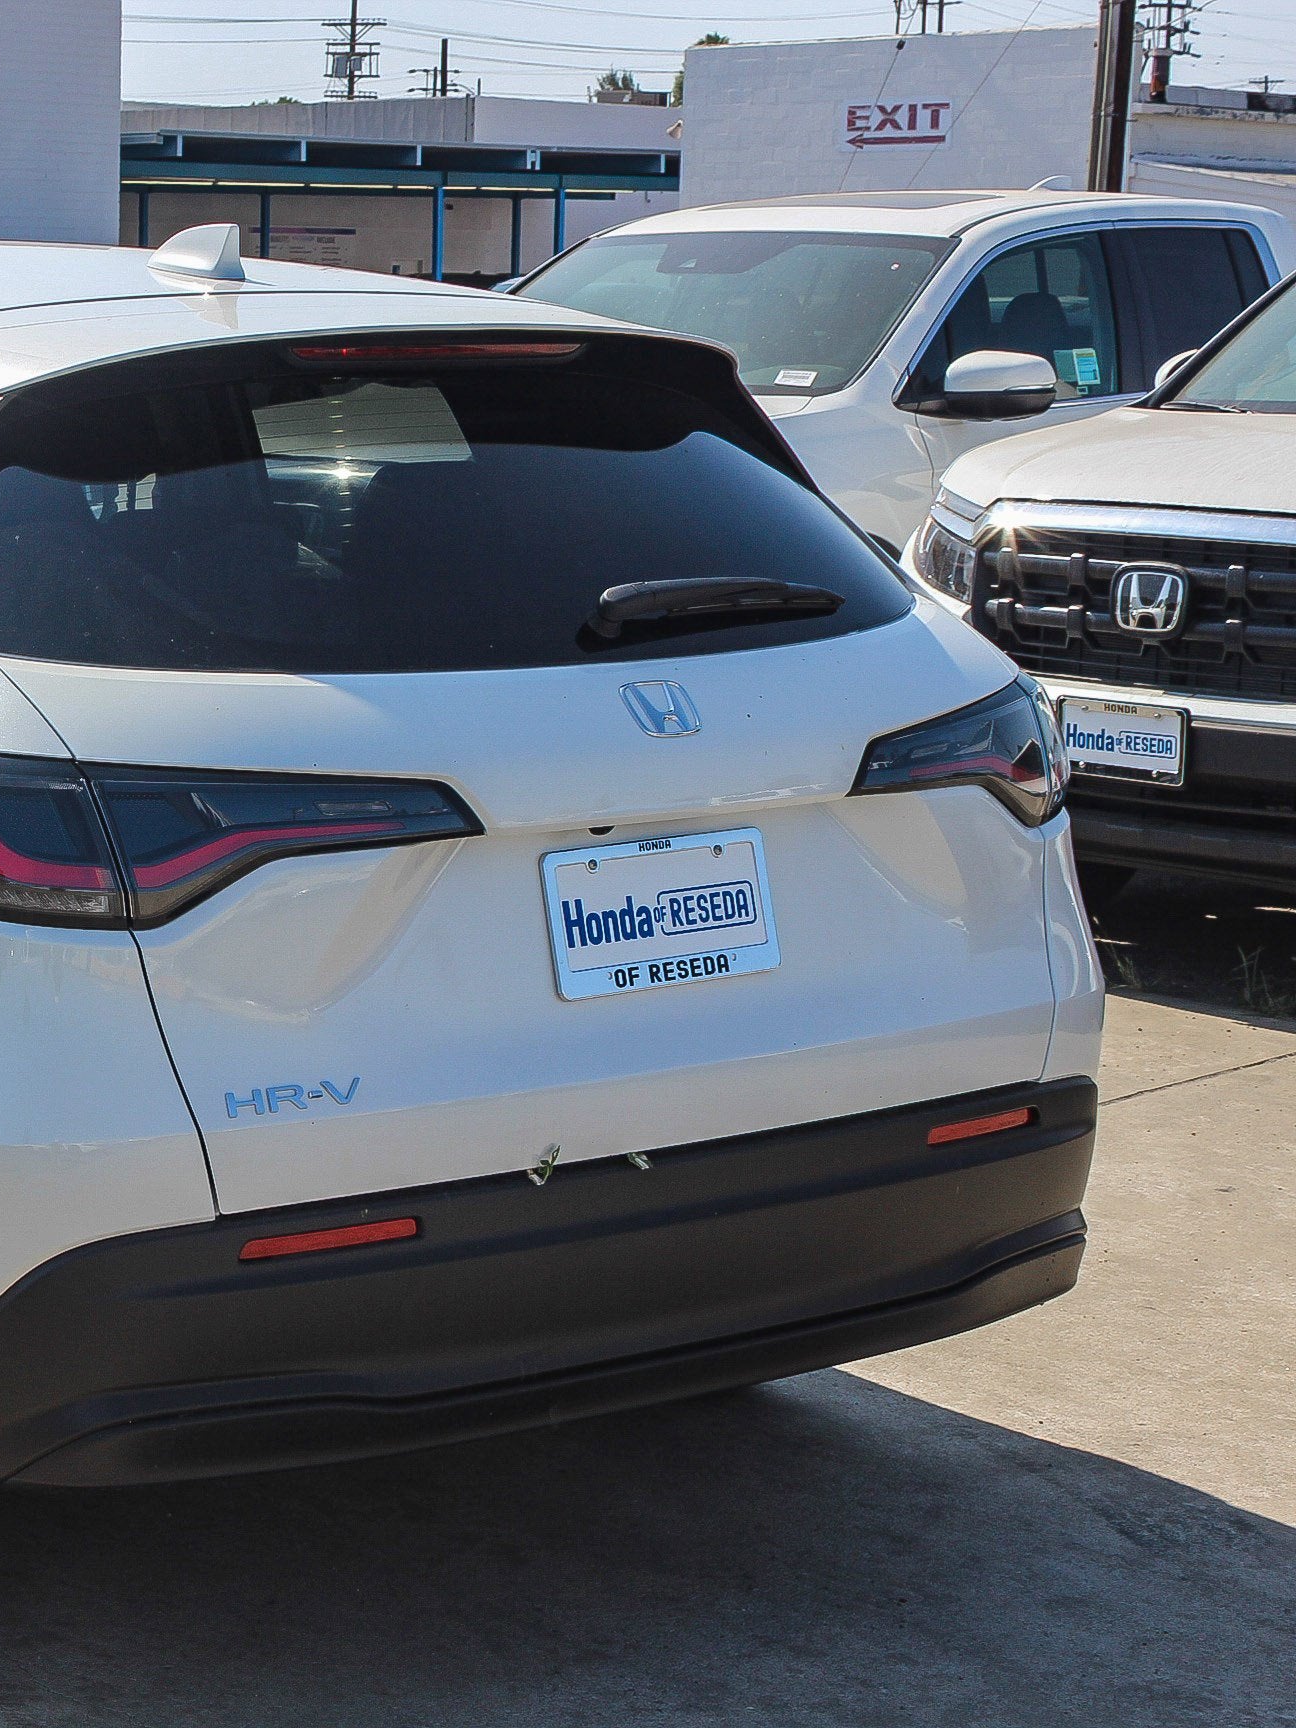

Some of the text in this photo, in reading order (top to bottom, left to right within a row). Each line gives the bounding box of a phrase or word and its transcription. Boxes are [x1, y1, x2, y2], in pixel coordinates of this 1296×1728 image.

[846, 102, 951, 132] EXIT
[1103, 703, 1138, 715] HONDA
[1065, 722, 1173, 756] Honda OF RESEDA
[637, 839, 672, 852] HONDA
[561, 888, 750, 949] Honda OF RESEDA
[613, 953, 731, 988] OF RESEDA
[224, 1077, 361, 1119] HR-V
